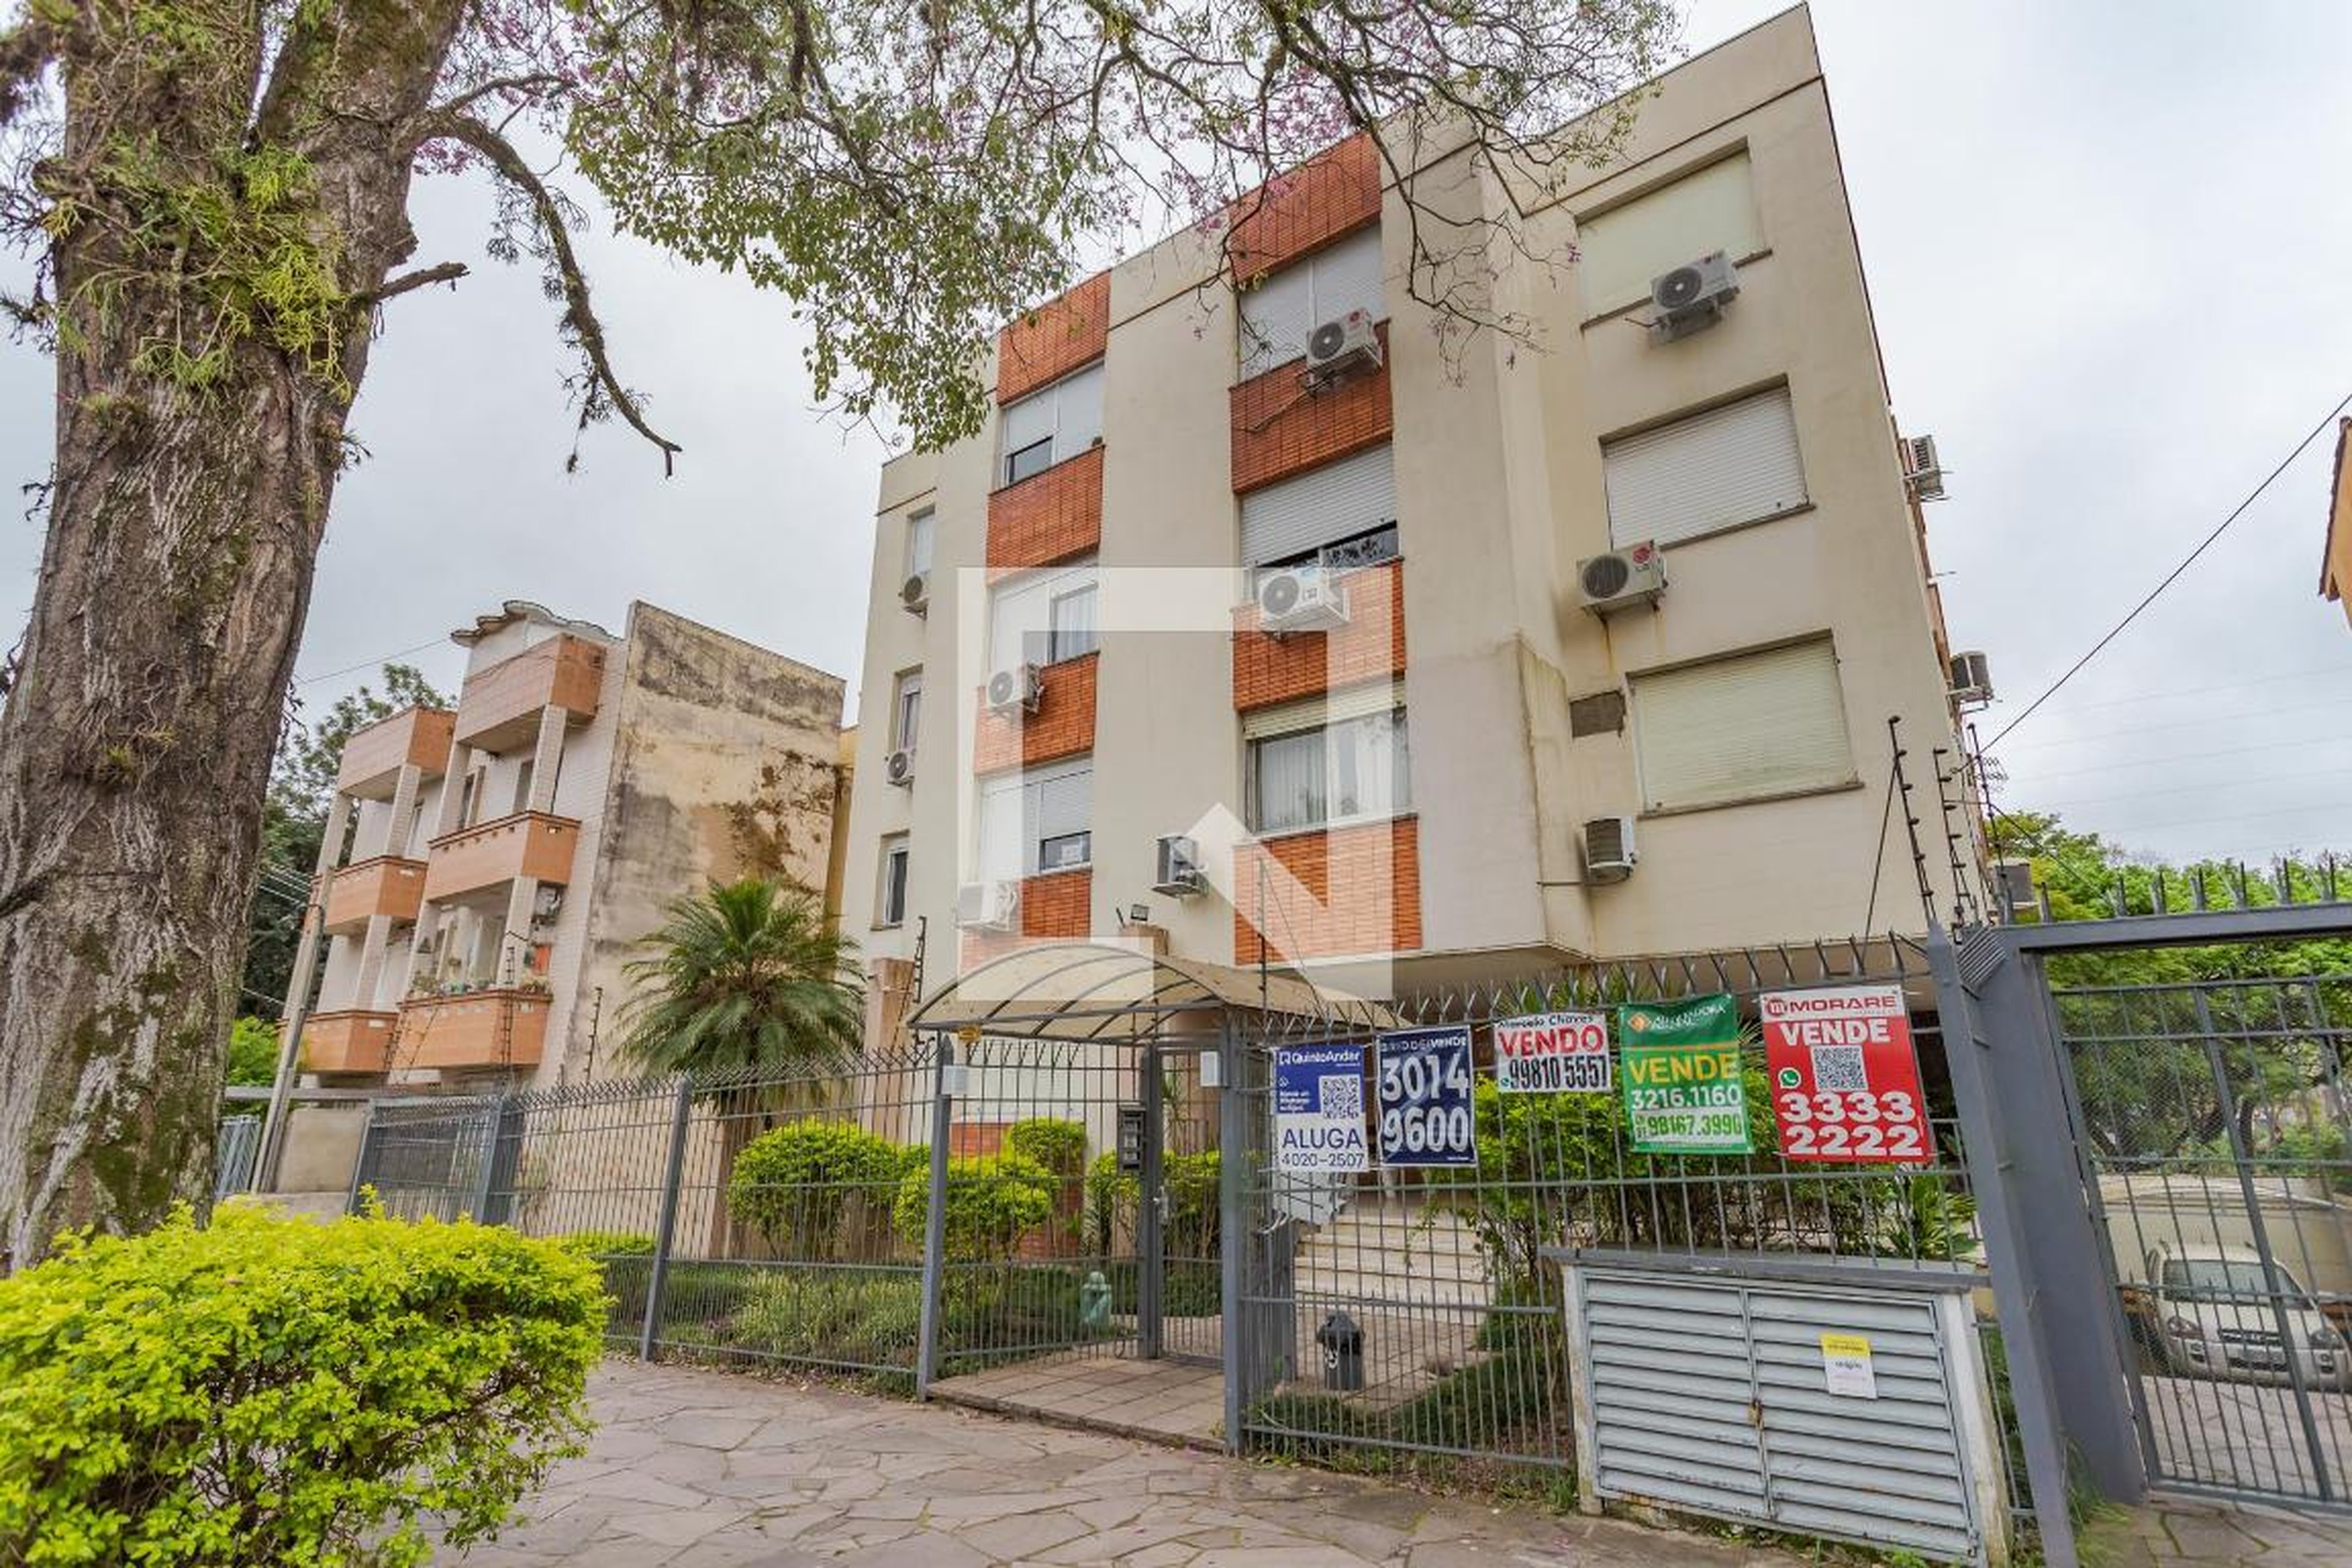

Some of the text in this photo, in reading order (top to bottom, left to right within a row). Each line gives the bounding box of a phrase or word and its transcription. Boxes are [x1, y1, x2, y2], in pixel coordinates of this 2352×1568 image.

[1790, 995, 1896, 1012] MORARE
[1498, 1025, 1604, 1057] VENDO
[1779, 1018, 1891, 1046] VENDE
[1382, 1053, 1469, 1102] 3014
[1509, 1055, 1607, 1089] 99810 5557
[1628, 1052, 1741, 1085] VENDE
[1632, 1084, 1741, 1110] 3216.1160
[1779, 1090, 1916, 1123] 3333
[1282, 1128, 1363, 1149] ALUGA
[1384, 1106, 1469, 1153] 9600
[1785, 1125, 1923, 1156] 2222
